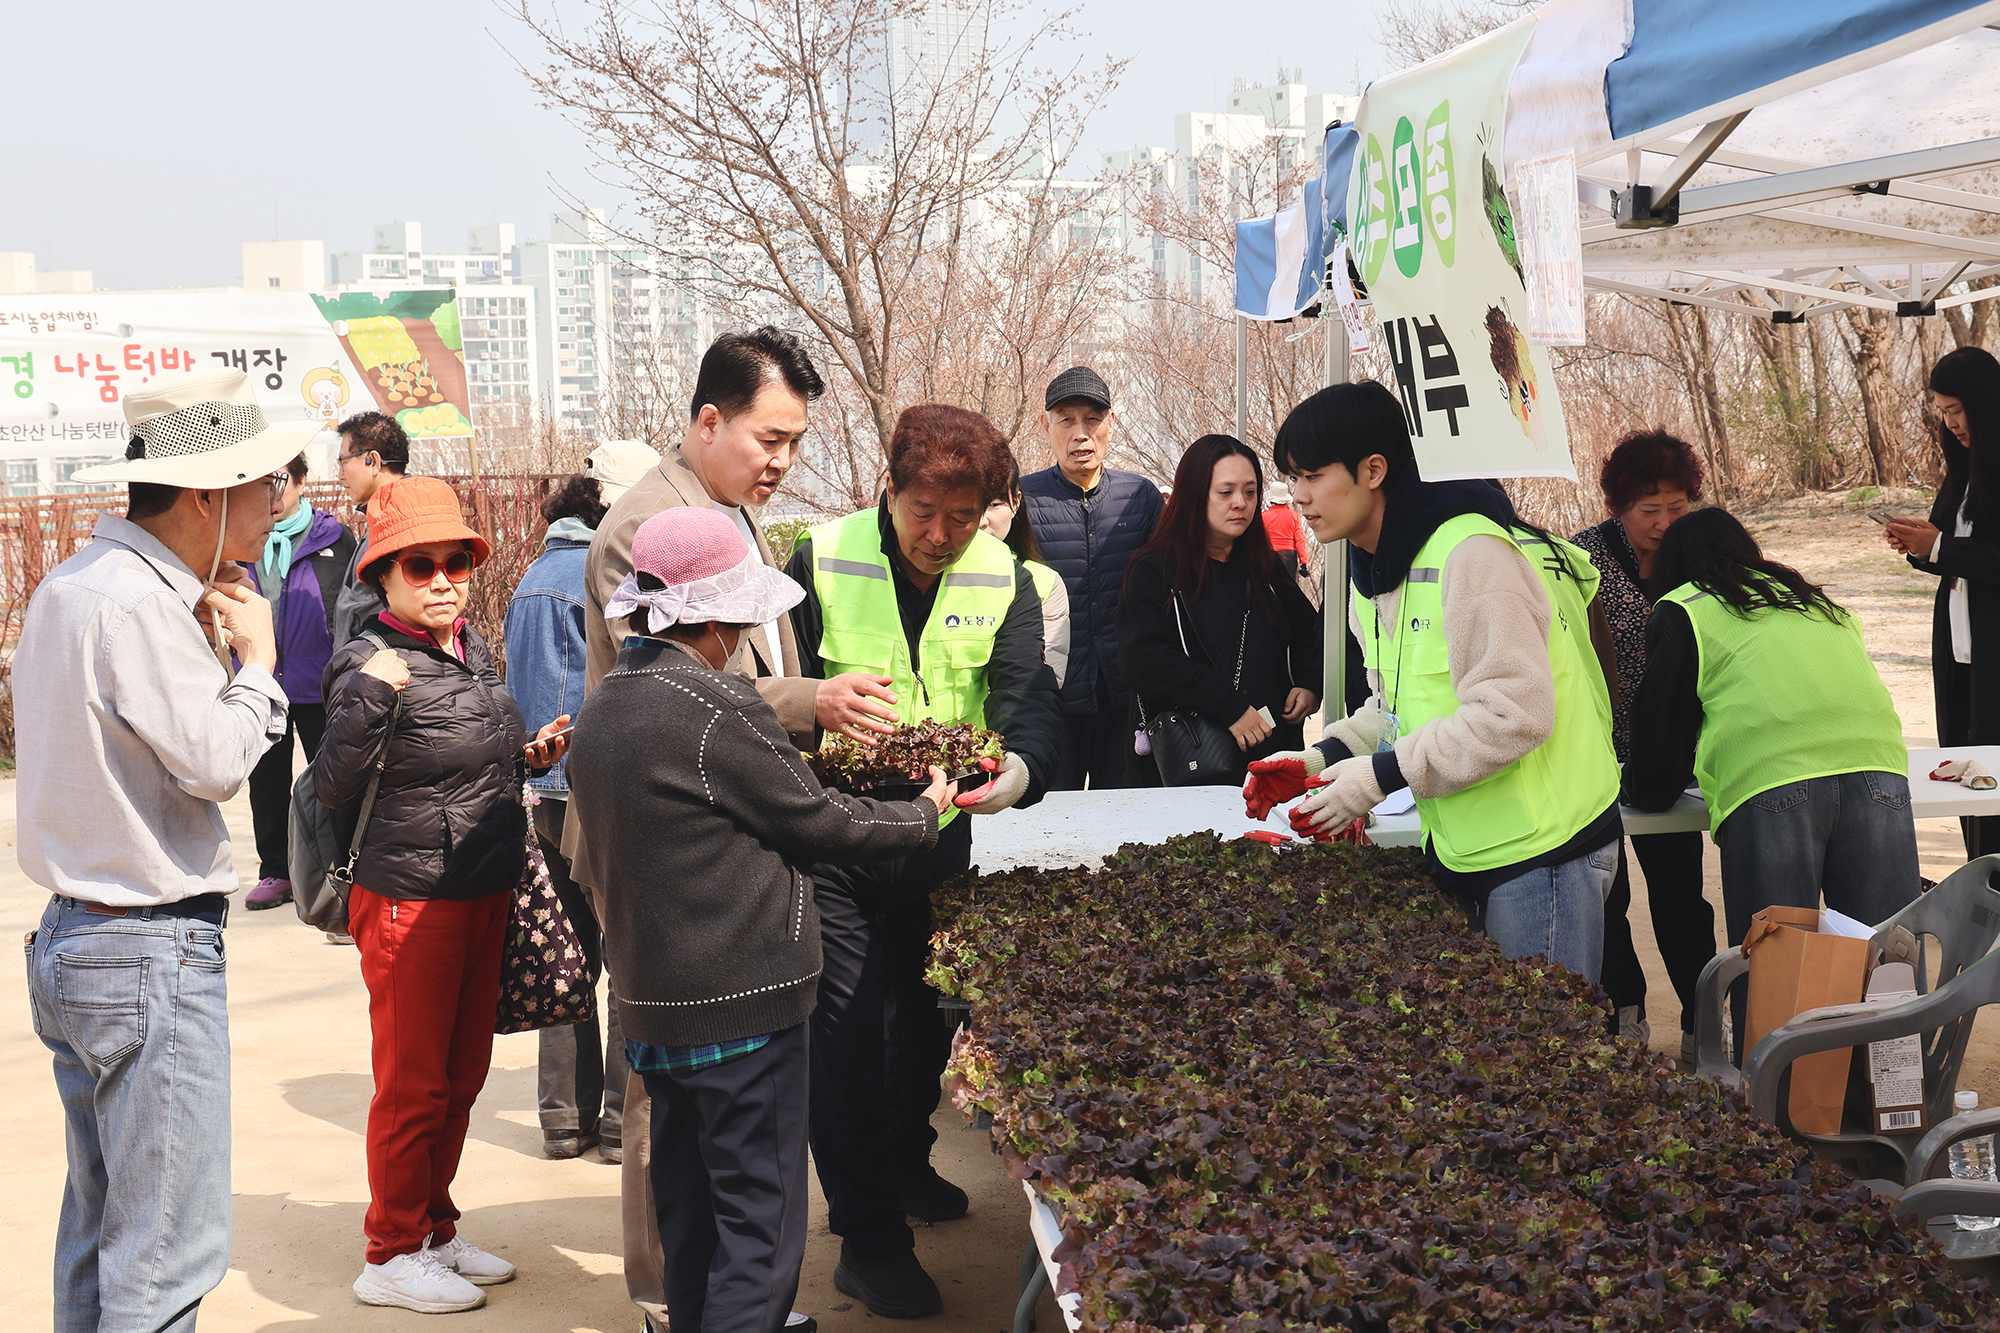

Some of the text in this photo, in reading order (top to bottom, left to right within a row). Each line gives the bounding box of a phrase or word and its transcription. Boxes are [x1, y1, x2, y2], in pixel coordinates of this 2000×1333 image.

[211, 348, 288, 391] 개장
[1383, 314, 1469, 438] 배부
[51, 420, 133, 441] 나눔텃밭(
[963, 615, 996, 626] 도봉구
